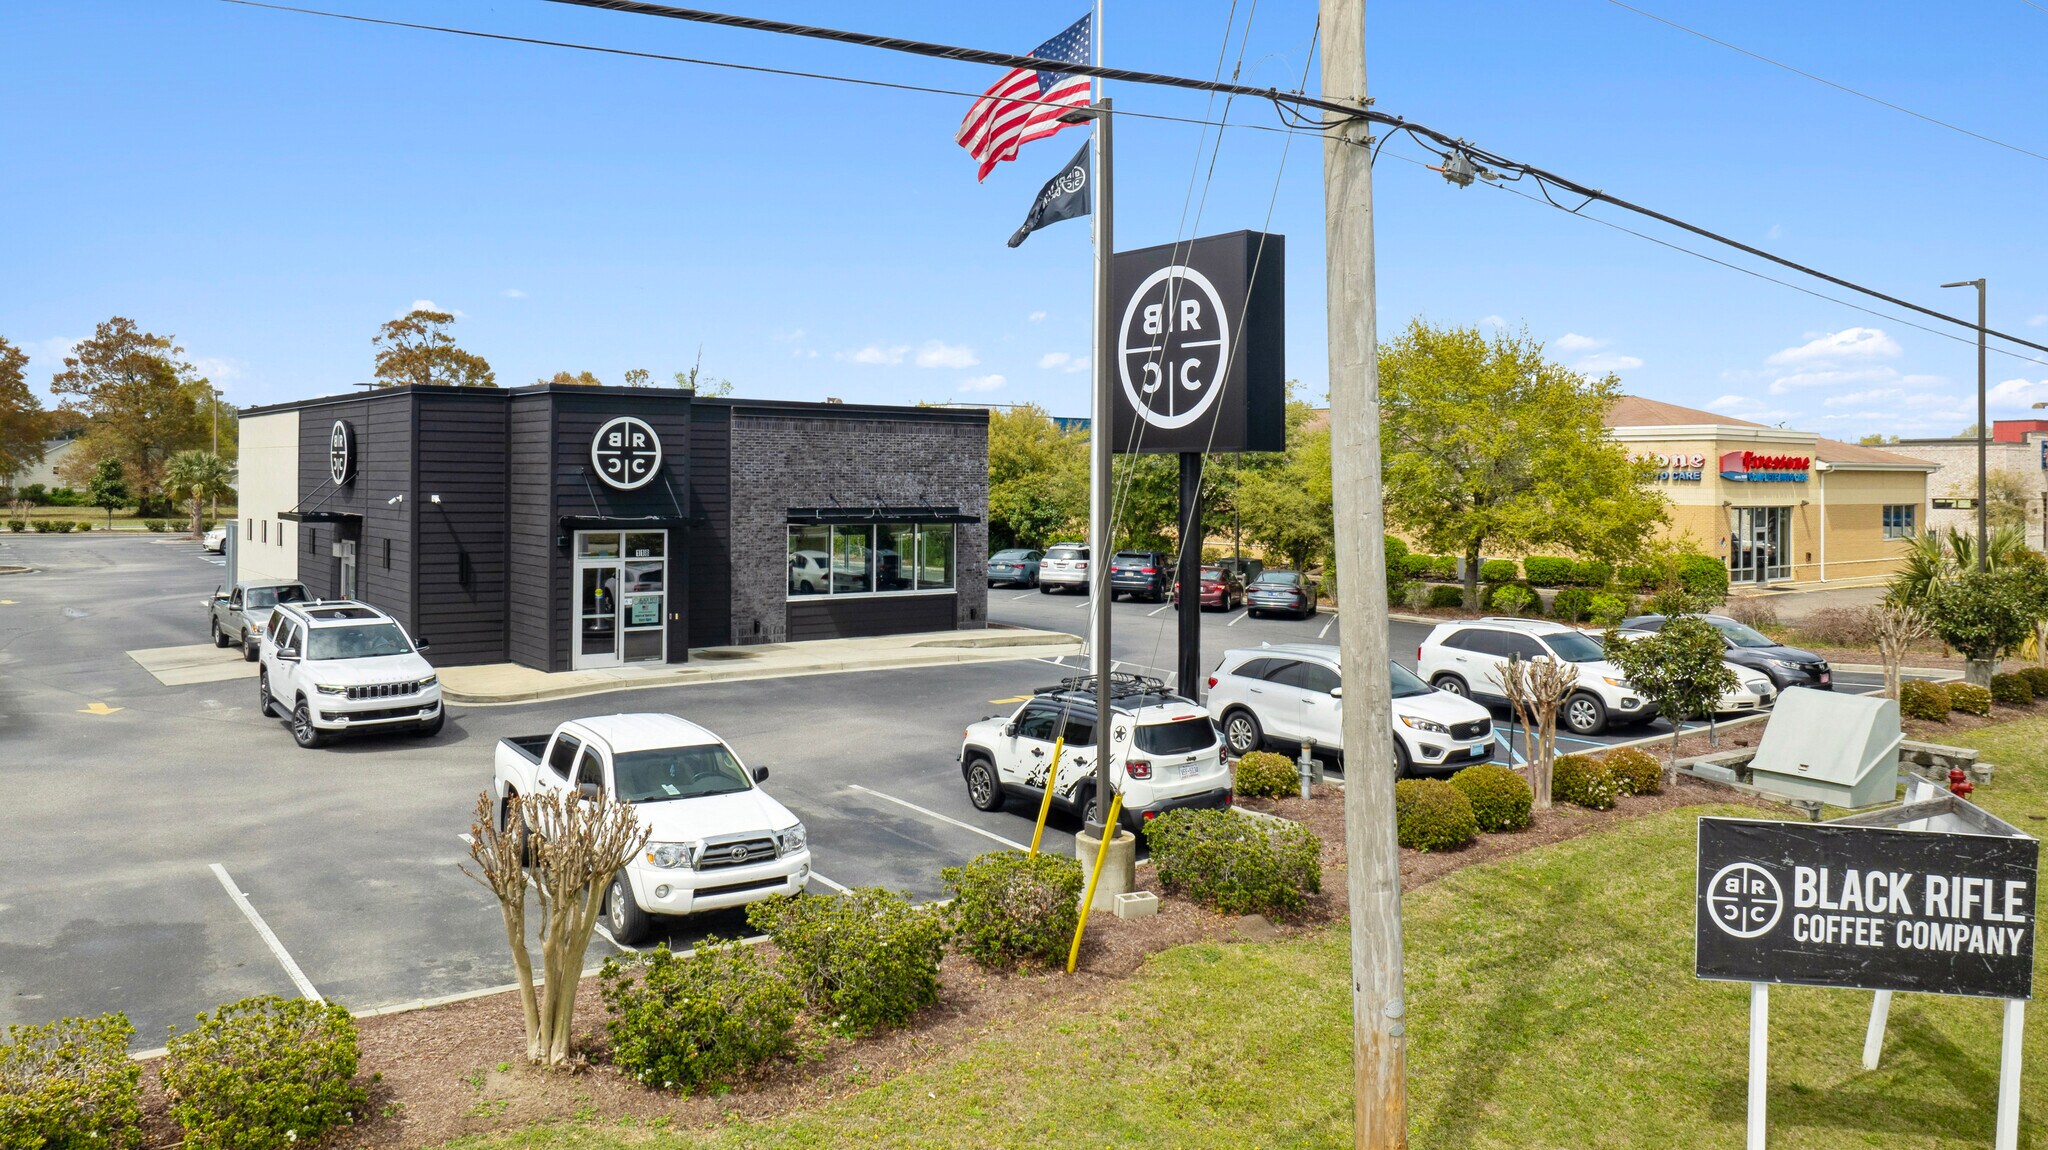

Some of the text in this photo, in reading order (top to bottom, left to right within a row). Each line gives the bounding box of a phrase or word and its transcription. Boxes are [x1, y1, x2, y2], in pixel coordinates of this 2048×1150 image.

[1672, 471, 1702, 480] CARE
[1794, 865, 2027, 923] BLACK RIFLE
[1793, 913, 2025, 957] COFFEE COMPANY
